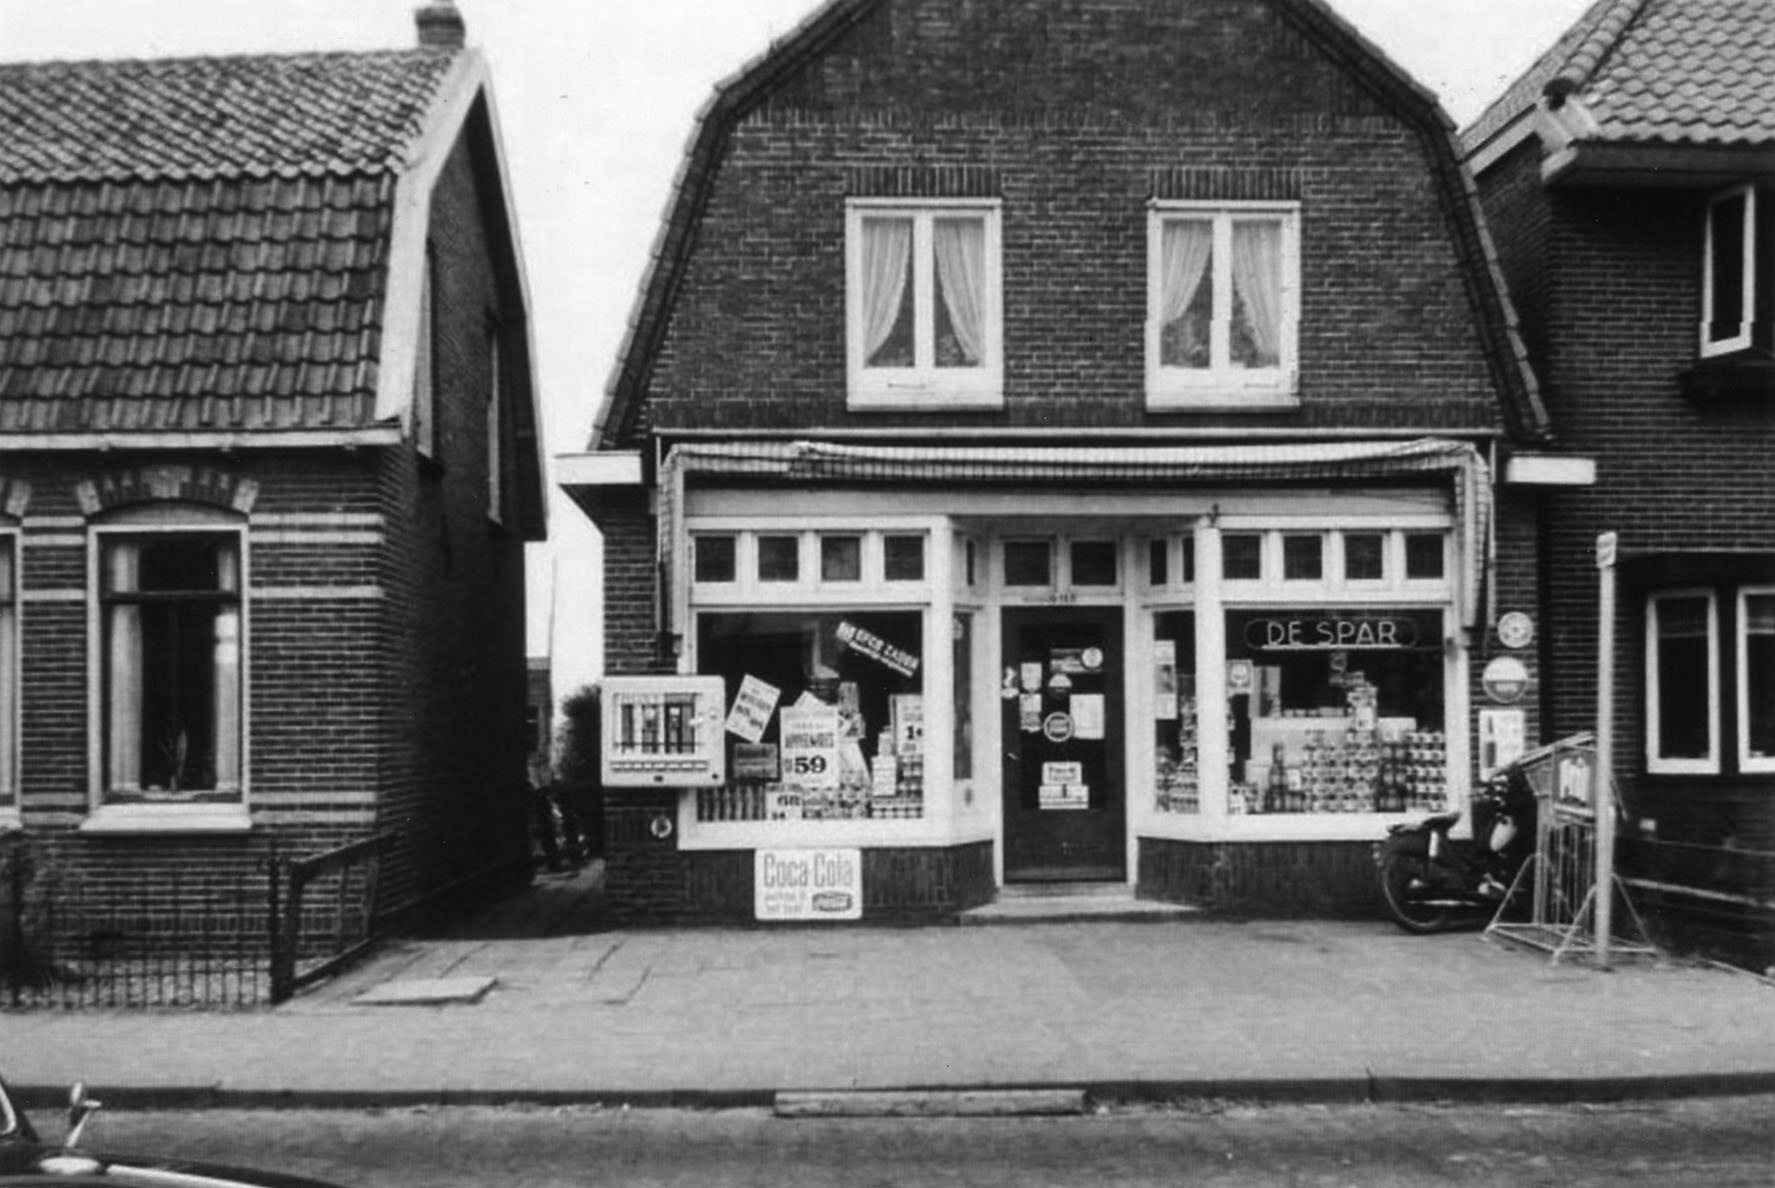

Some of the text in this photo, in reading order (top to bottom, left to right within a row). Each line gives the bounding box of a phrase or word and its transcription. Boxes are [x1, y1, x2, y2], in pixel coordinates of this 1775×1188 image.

[1267, 620, 1397, 645] DE SPAR
[794, 754, 828, 775] 59
